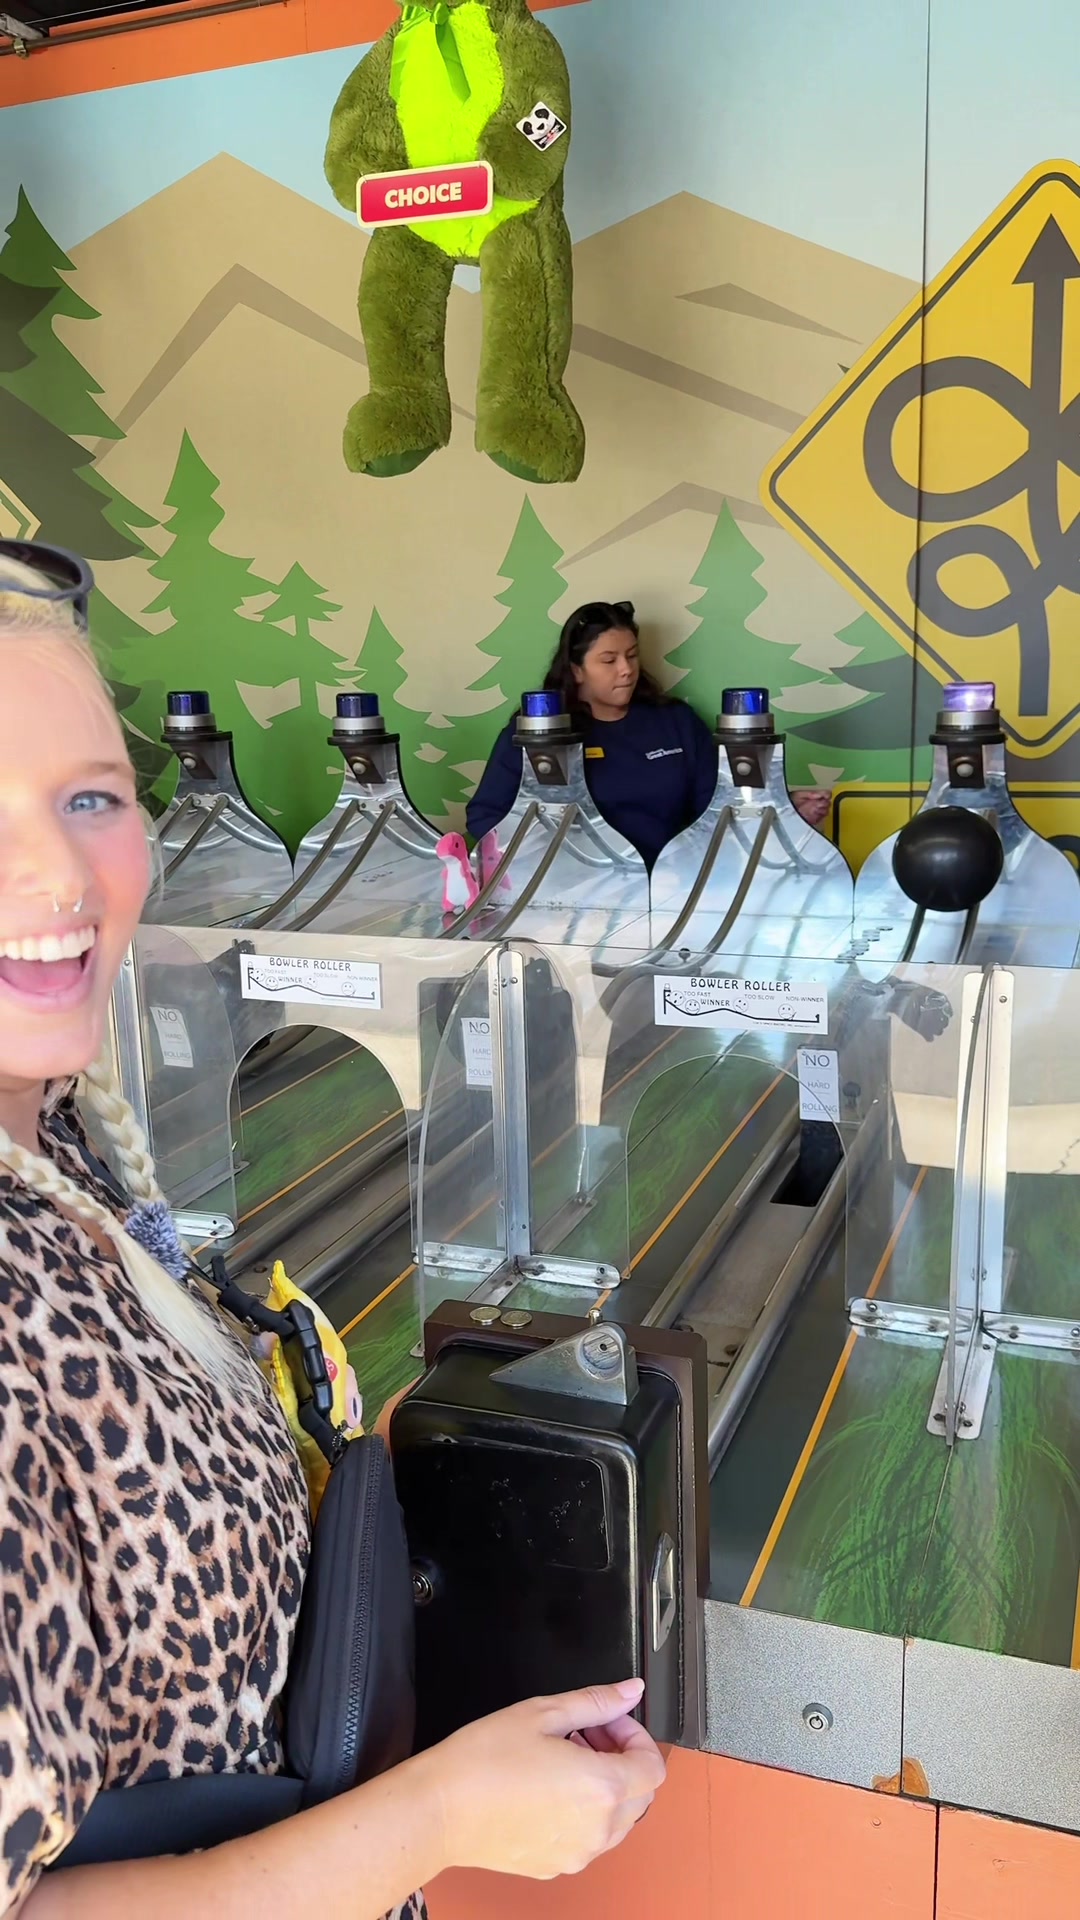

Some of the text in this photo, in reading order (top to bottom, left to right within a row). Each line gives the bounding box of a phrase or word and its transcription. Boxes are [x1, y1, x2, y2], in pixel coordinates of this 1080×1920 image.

[384, 181, 462, 209] CHOICE
[269, 957, 352, 972] BOWLER ROLLER
[277, 976, 303, 984] WINNER
[690, 977, 791, 992] BOWLER ROLLER
[700, 999, 730, 1007] WINNER
[157, 1009, 178, 1022] NO
[469, 1021, 490, 1035] NO
[805, 1054, 830, 1068] NO
[807, 1081, 830, 1090] HARD
